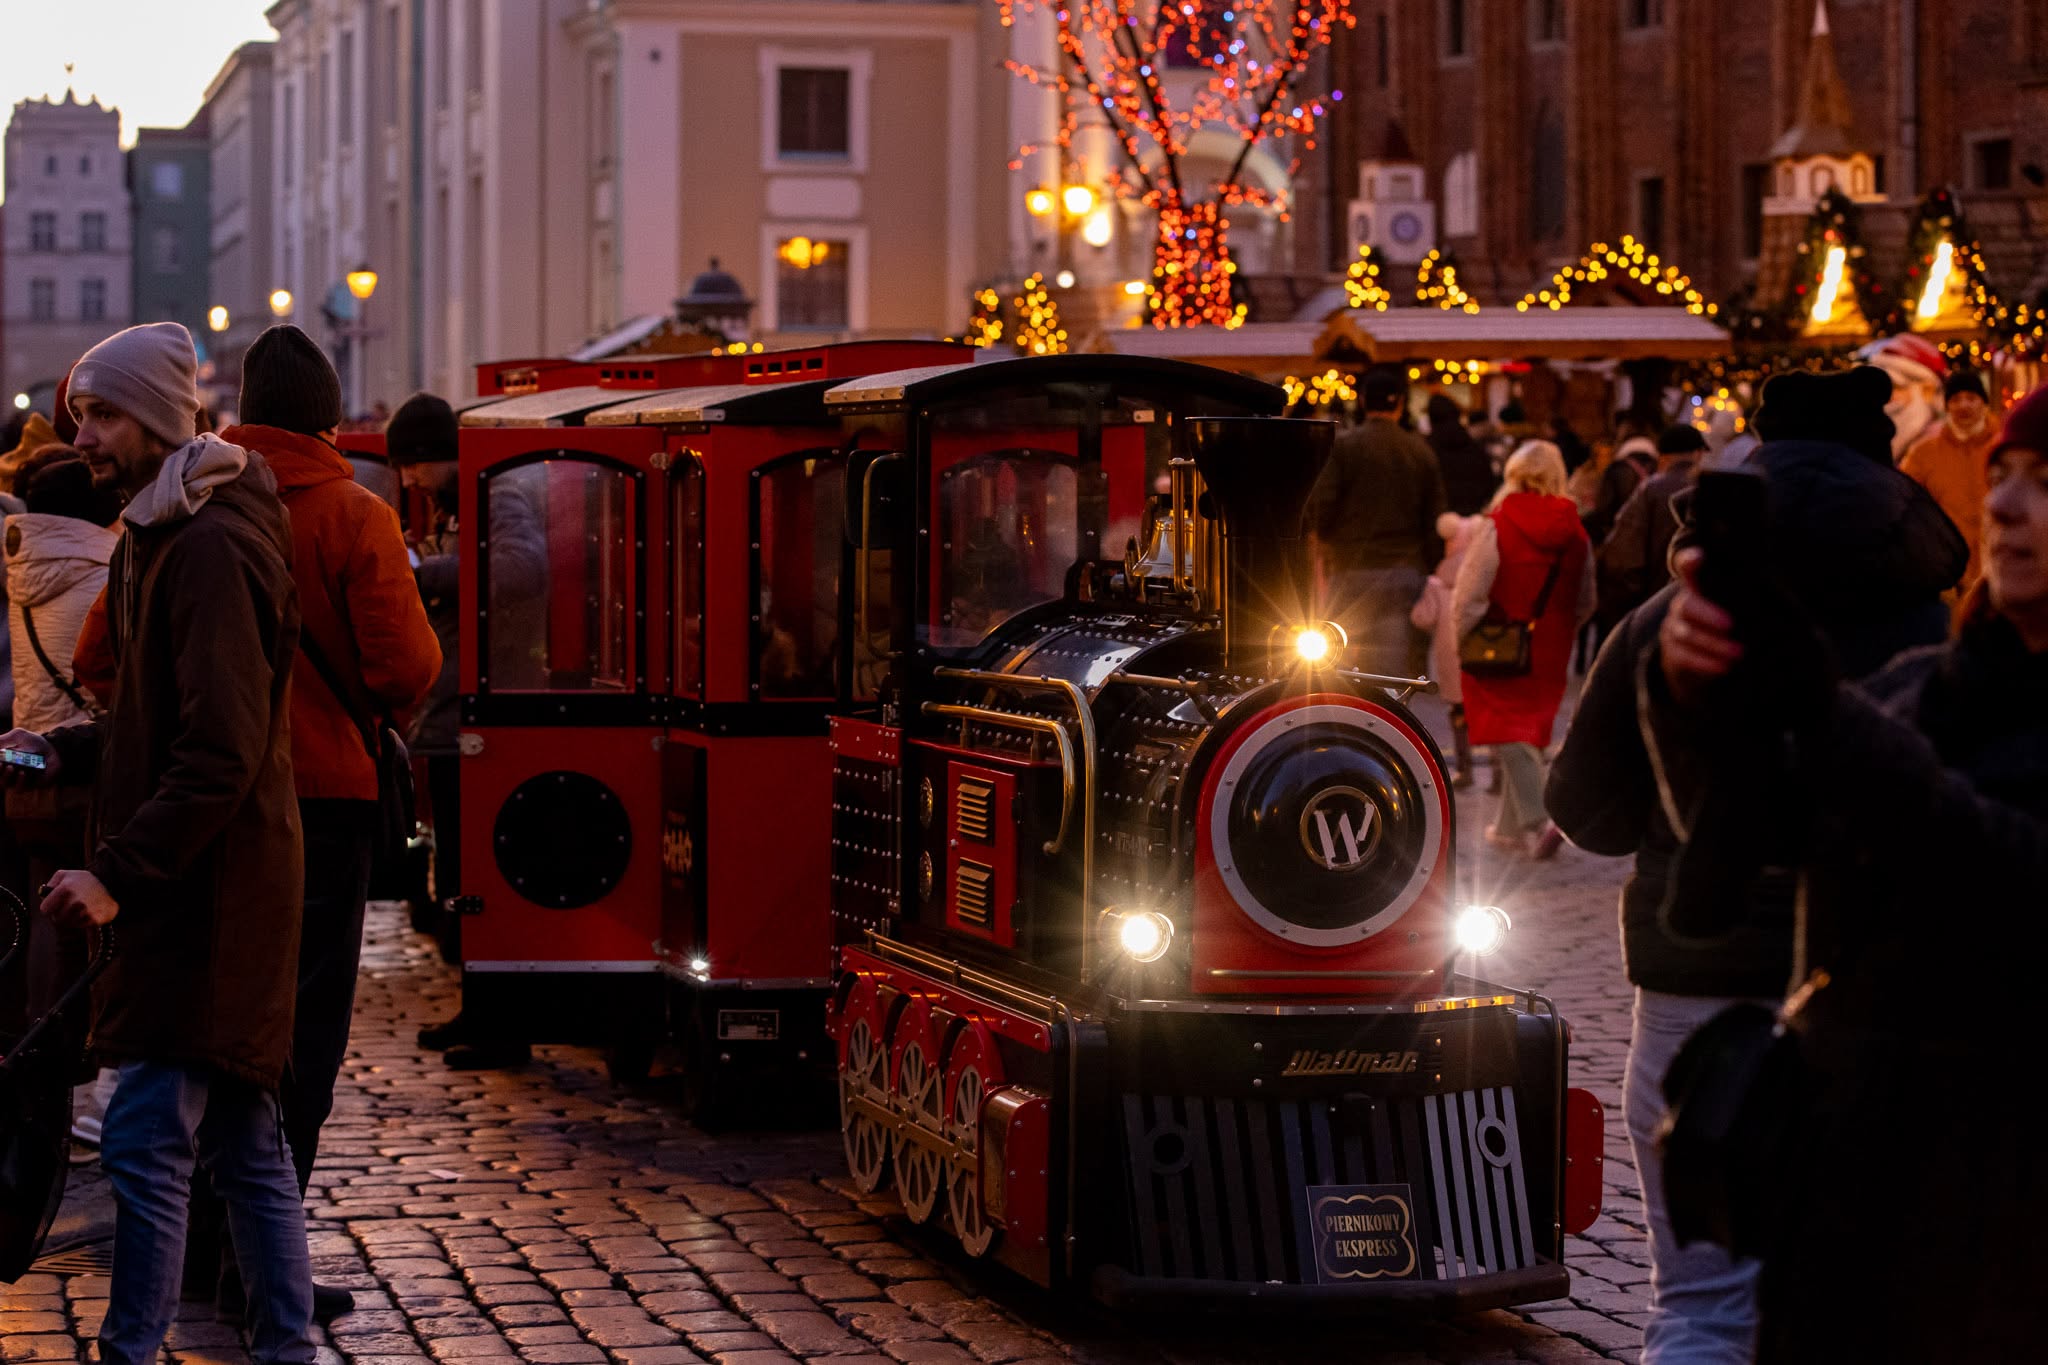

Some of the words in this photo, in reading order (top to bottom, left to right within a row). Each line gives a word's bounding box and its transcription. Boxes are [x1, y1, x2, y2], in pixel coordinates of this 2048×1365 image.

[1313, 801, 1375, 869] W
[1280, 1049, 1419, 1077] Wattman
[1325, 1213, 1400, 1233] PIERNIKOWY
[1335, 1239, 1398, 1258] EKSPRESS
